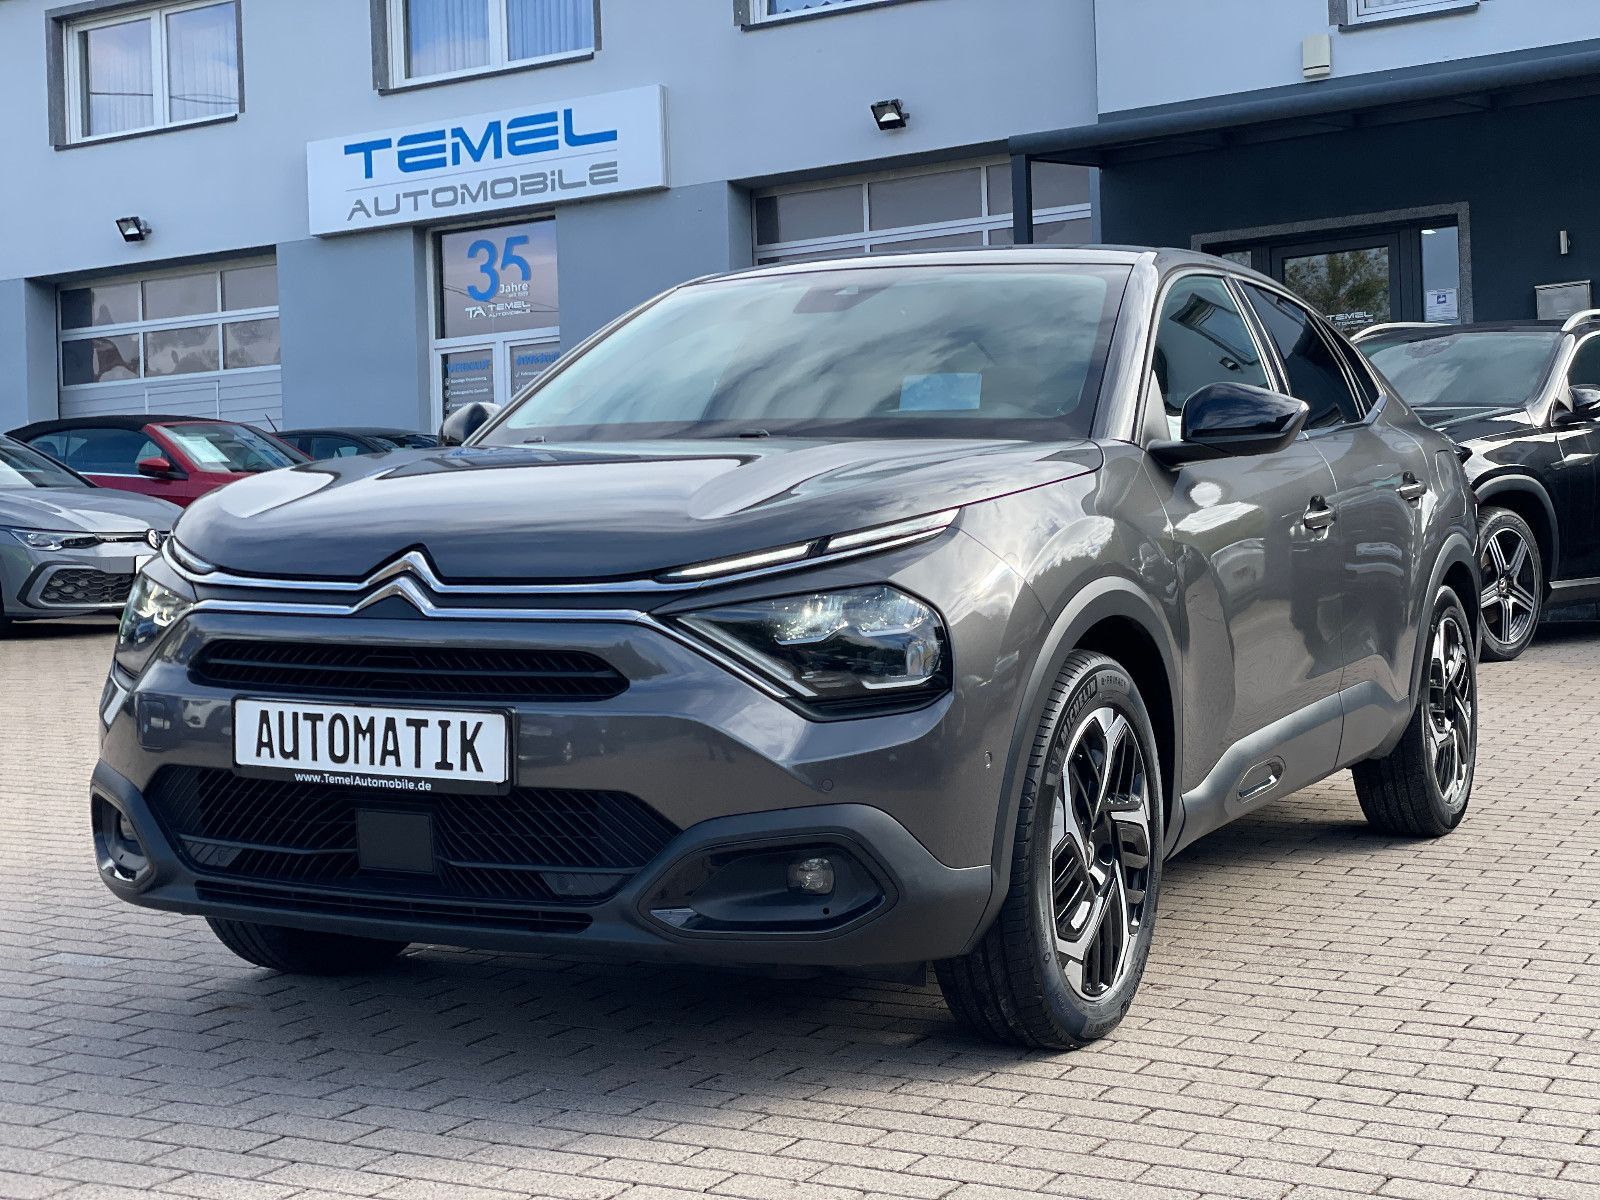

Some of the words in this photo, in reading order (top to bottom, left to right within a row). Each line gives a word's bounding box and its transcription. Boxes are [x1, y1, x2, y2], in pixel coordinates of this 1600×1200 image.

[344, 108, 618, 180] TEMEL
[467, 235, 532, 303] 35
[500, 282, 529, 294] Jahre
[488, 301, 531, 311] TEMEL
[1326, 311, 1373, 321] TEMEL
[255, 709, 484, 773] AUTOMATIK
[294, 773, 432, 791] www.TemelAutomobile.de
